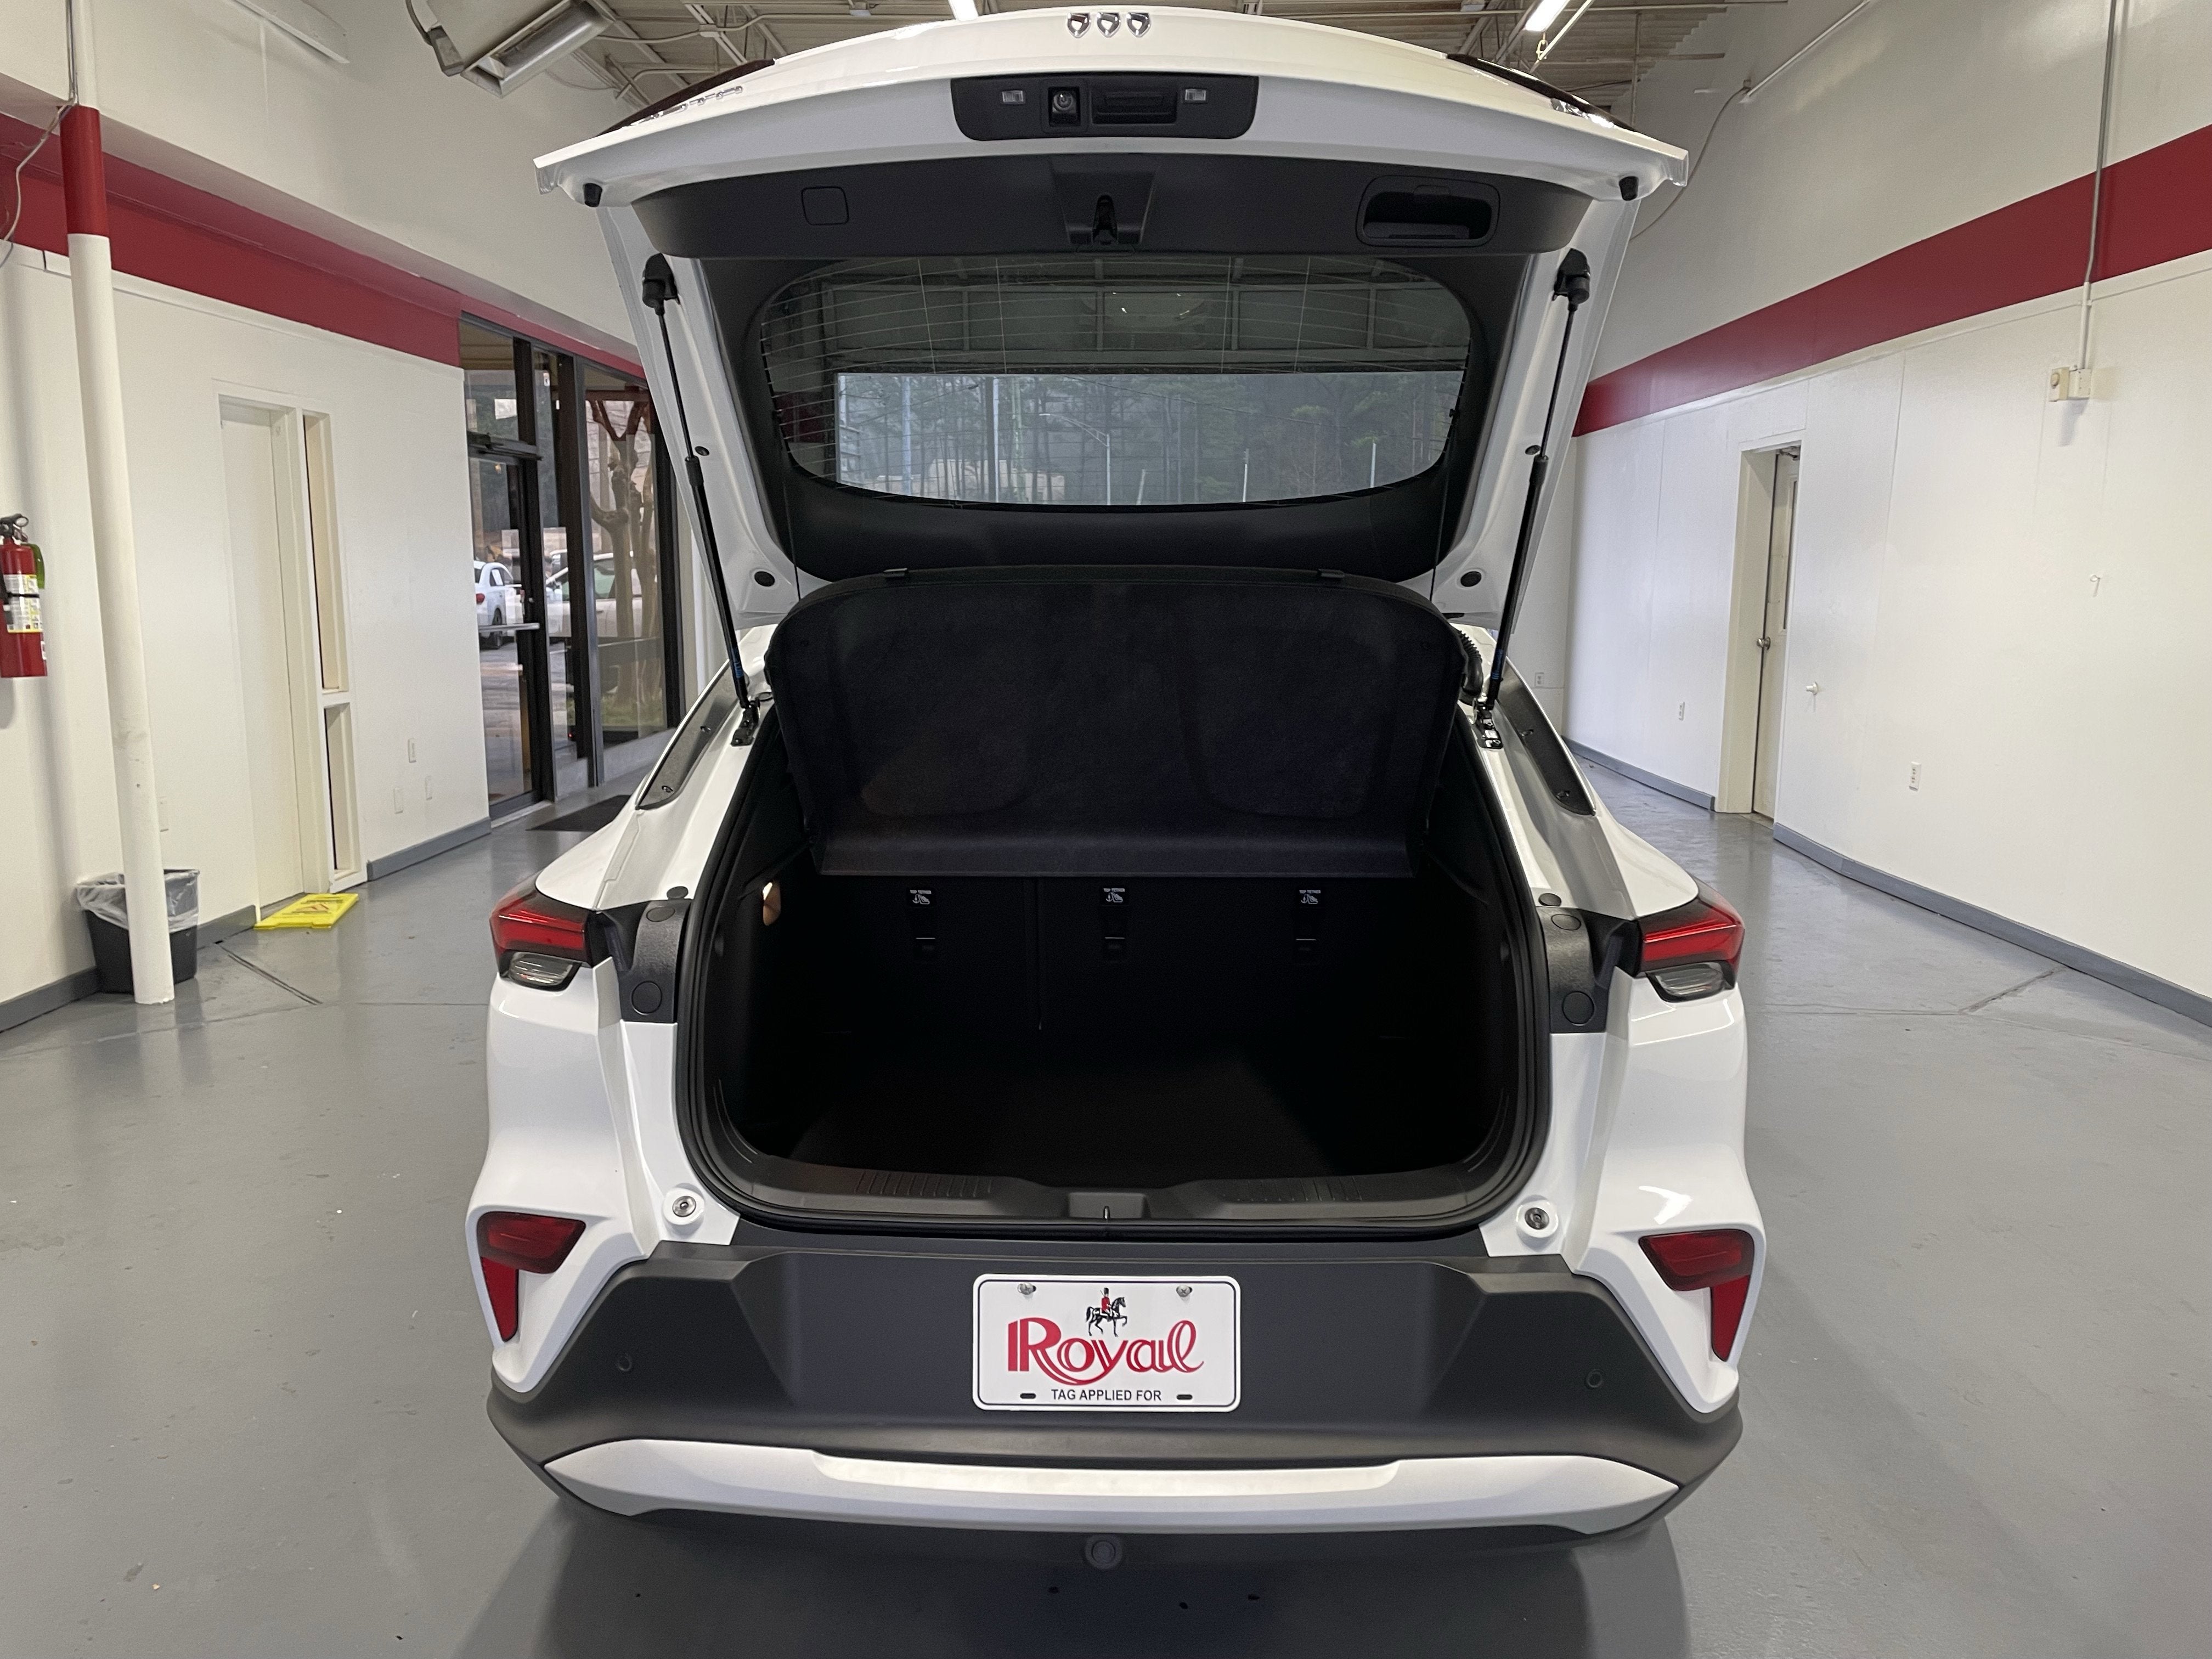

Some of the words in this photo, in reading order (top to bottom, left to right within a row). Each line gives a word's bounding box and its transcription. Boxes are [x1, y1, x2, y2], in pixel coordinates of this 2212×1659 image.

[1007, 1317, 1205, 1386] Royal
[1051, 1388, 1076, 1400] TAG
[1079, 1389, 1132, 1401] APPLIED
[1136, 1390, 1162, 1402] FOR
